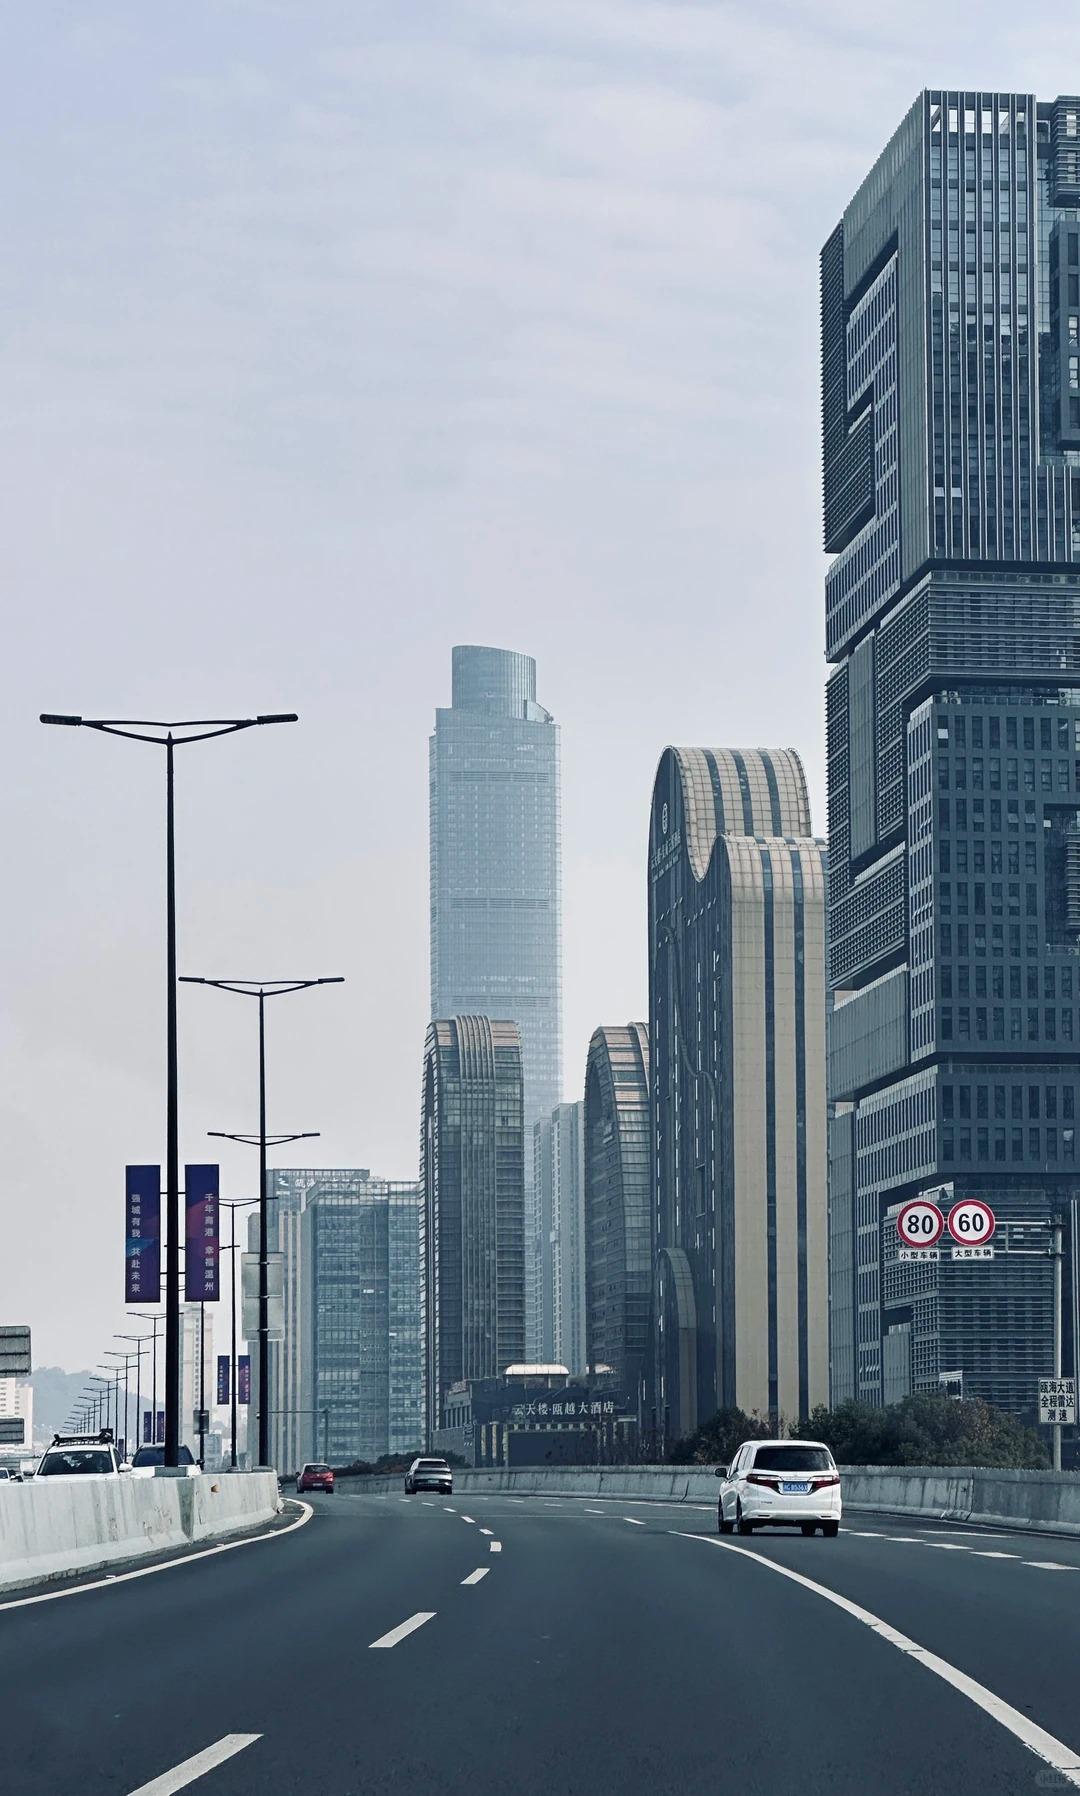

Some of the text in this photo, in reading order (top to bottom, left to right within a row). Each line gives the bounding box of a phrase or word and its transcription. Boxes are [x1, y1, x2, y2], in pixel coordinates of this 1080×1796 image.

[907, 1215, 933, 1234] 80
[958, 1213, 984, 1232] 60
[204, 1193, 214, 1291] 千年商港 幸福温州
[901, 1251, 938, 1260] 小型车辆
[955, 1249, 992, 1258] 大型车辆
[131, 1247, 141, 1293] 共赴未来
[1040, 1381, 1075, 1394] 瓯海大道
[1041, 1395, 1075, 1408] 全程雷达
[1047, 1409, 1068, 1421] 测速
